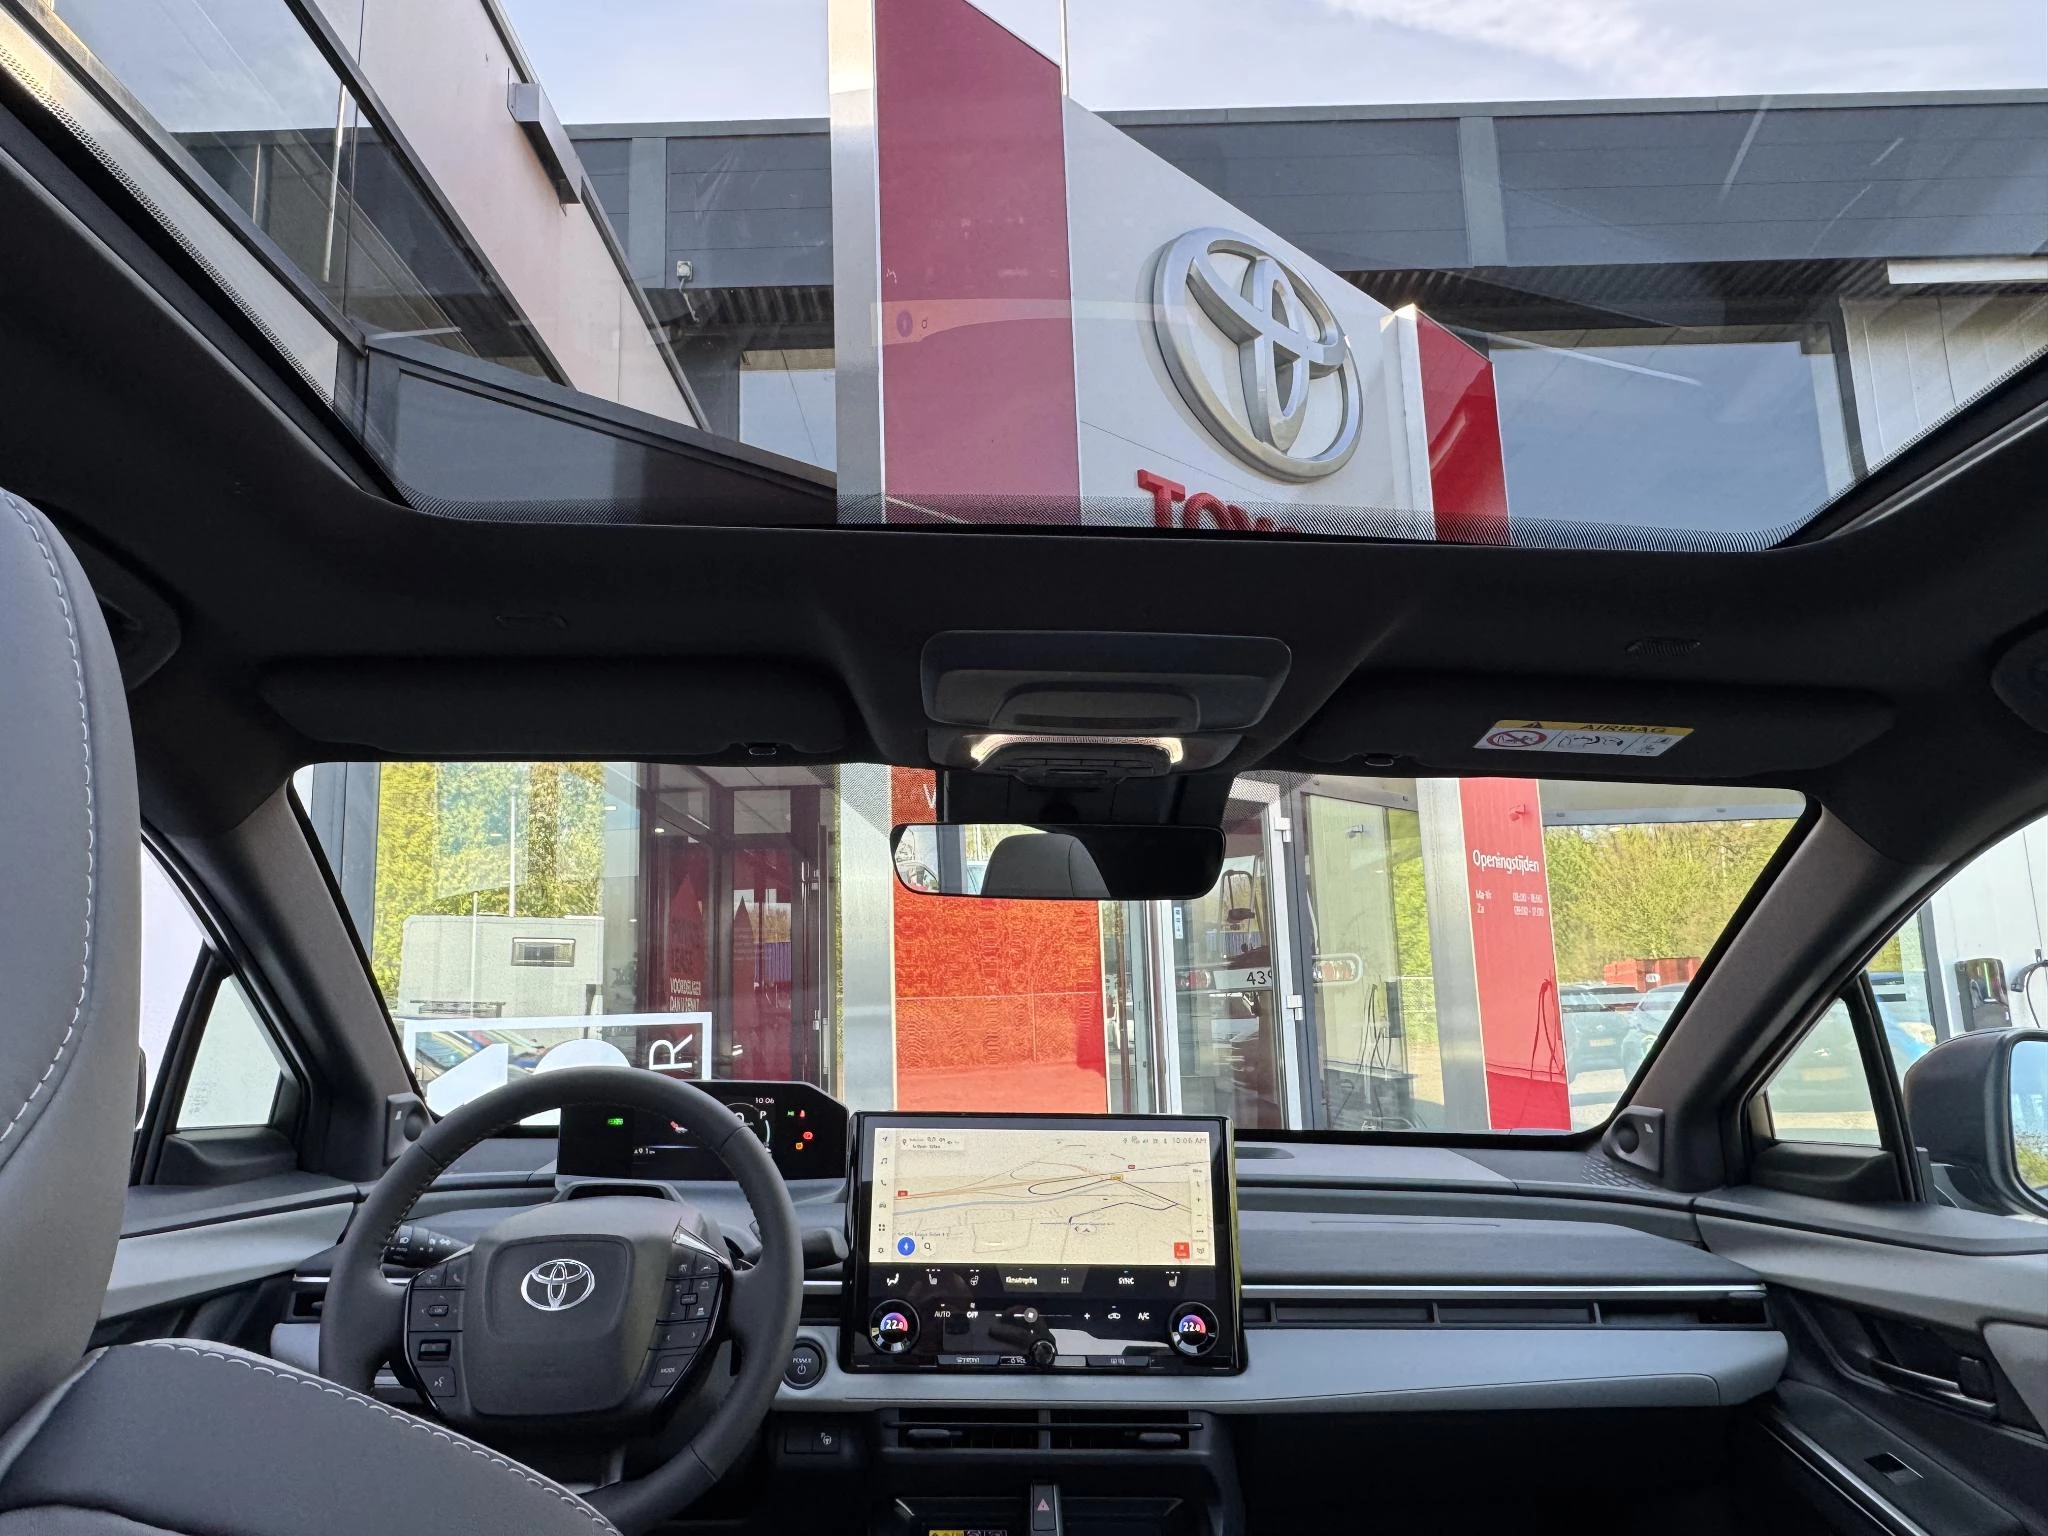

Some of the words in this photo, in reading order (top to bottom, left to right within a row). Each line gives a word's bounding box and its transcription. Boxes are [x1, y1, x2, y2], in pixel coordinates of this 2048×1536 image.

[1579, 724, 1666, 733] AIRBAG
[1472, 849, 1539, 876] Openingstijden
[760, 1110, 768, 1119] P
[1118, 1277, 1135, 1285] SYNC
[1137, 1312, 1150, 1320] A/C
